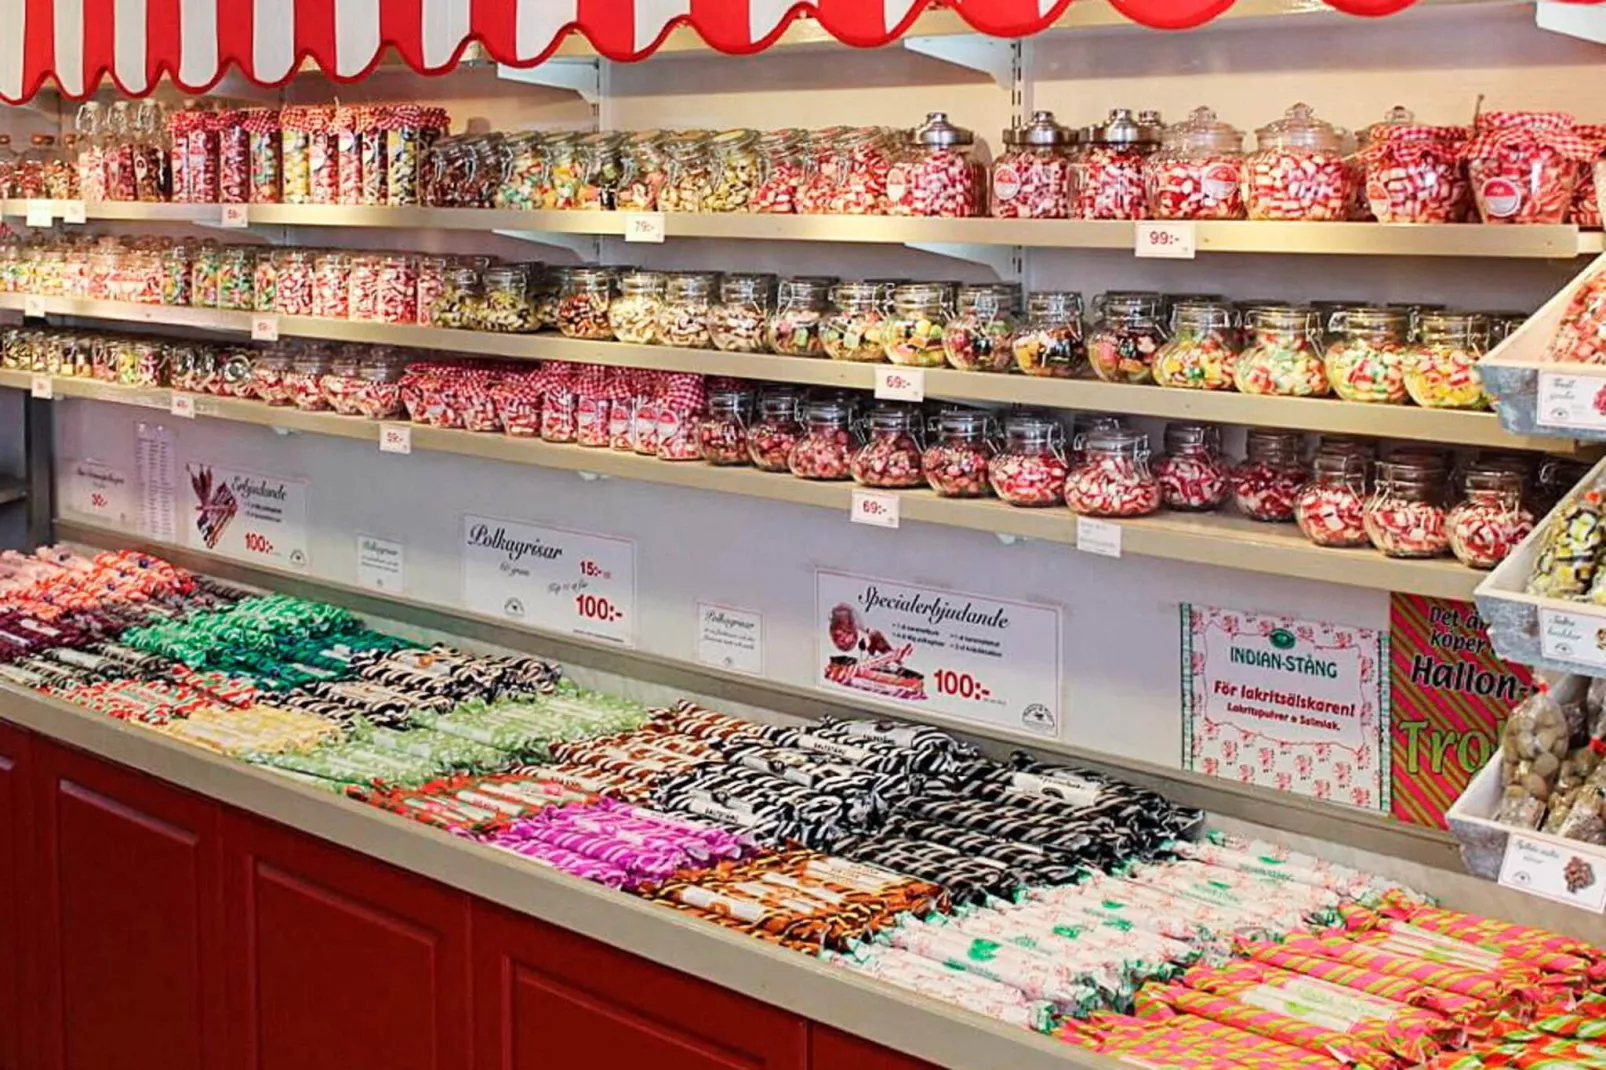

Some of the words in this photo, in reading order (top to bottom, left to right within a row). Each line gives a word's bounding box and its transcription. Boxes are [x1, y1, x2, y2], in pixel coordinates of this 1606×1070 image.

[634, 220, 655, 233] 79:-
[1149, 230, 1180, 245] 99:-
[885, 375, 912, 389] 69:-
[862, 500, 887, 515] 69:-
[245, 532, 273, 554] 100:-
[467, 523, 563, 561] Polkagrisar
[579, 560, 602, 577] 15:-
[575, 593, 623, 622] 100:-
[857, 585, 1010, 629] Specialerbjudande
[1429, 605, 1460, 626] Det
[1430, 629, 1486, 655] köper
[1229, 646, 1338, 679] INDIAN-STÅNG
[933, 668, 991, 701] 100:-
[1411, 653, 1530, 700] Hallon-
[1213, 680, 1238, 697] För
[1240, 684, 1356, 718] lakritsälskaren!
[1226, 702, 1289, 723] Lakritspulver
